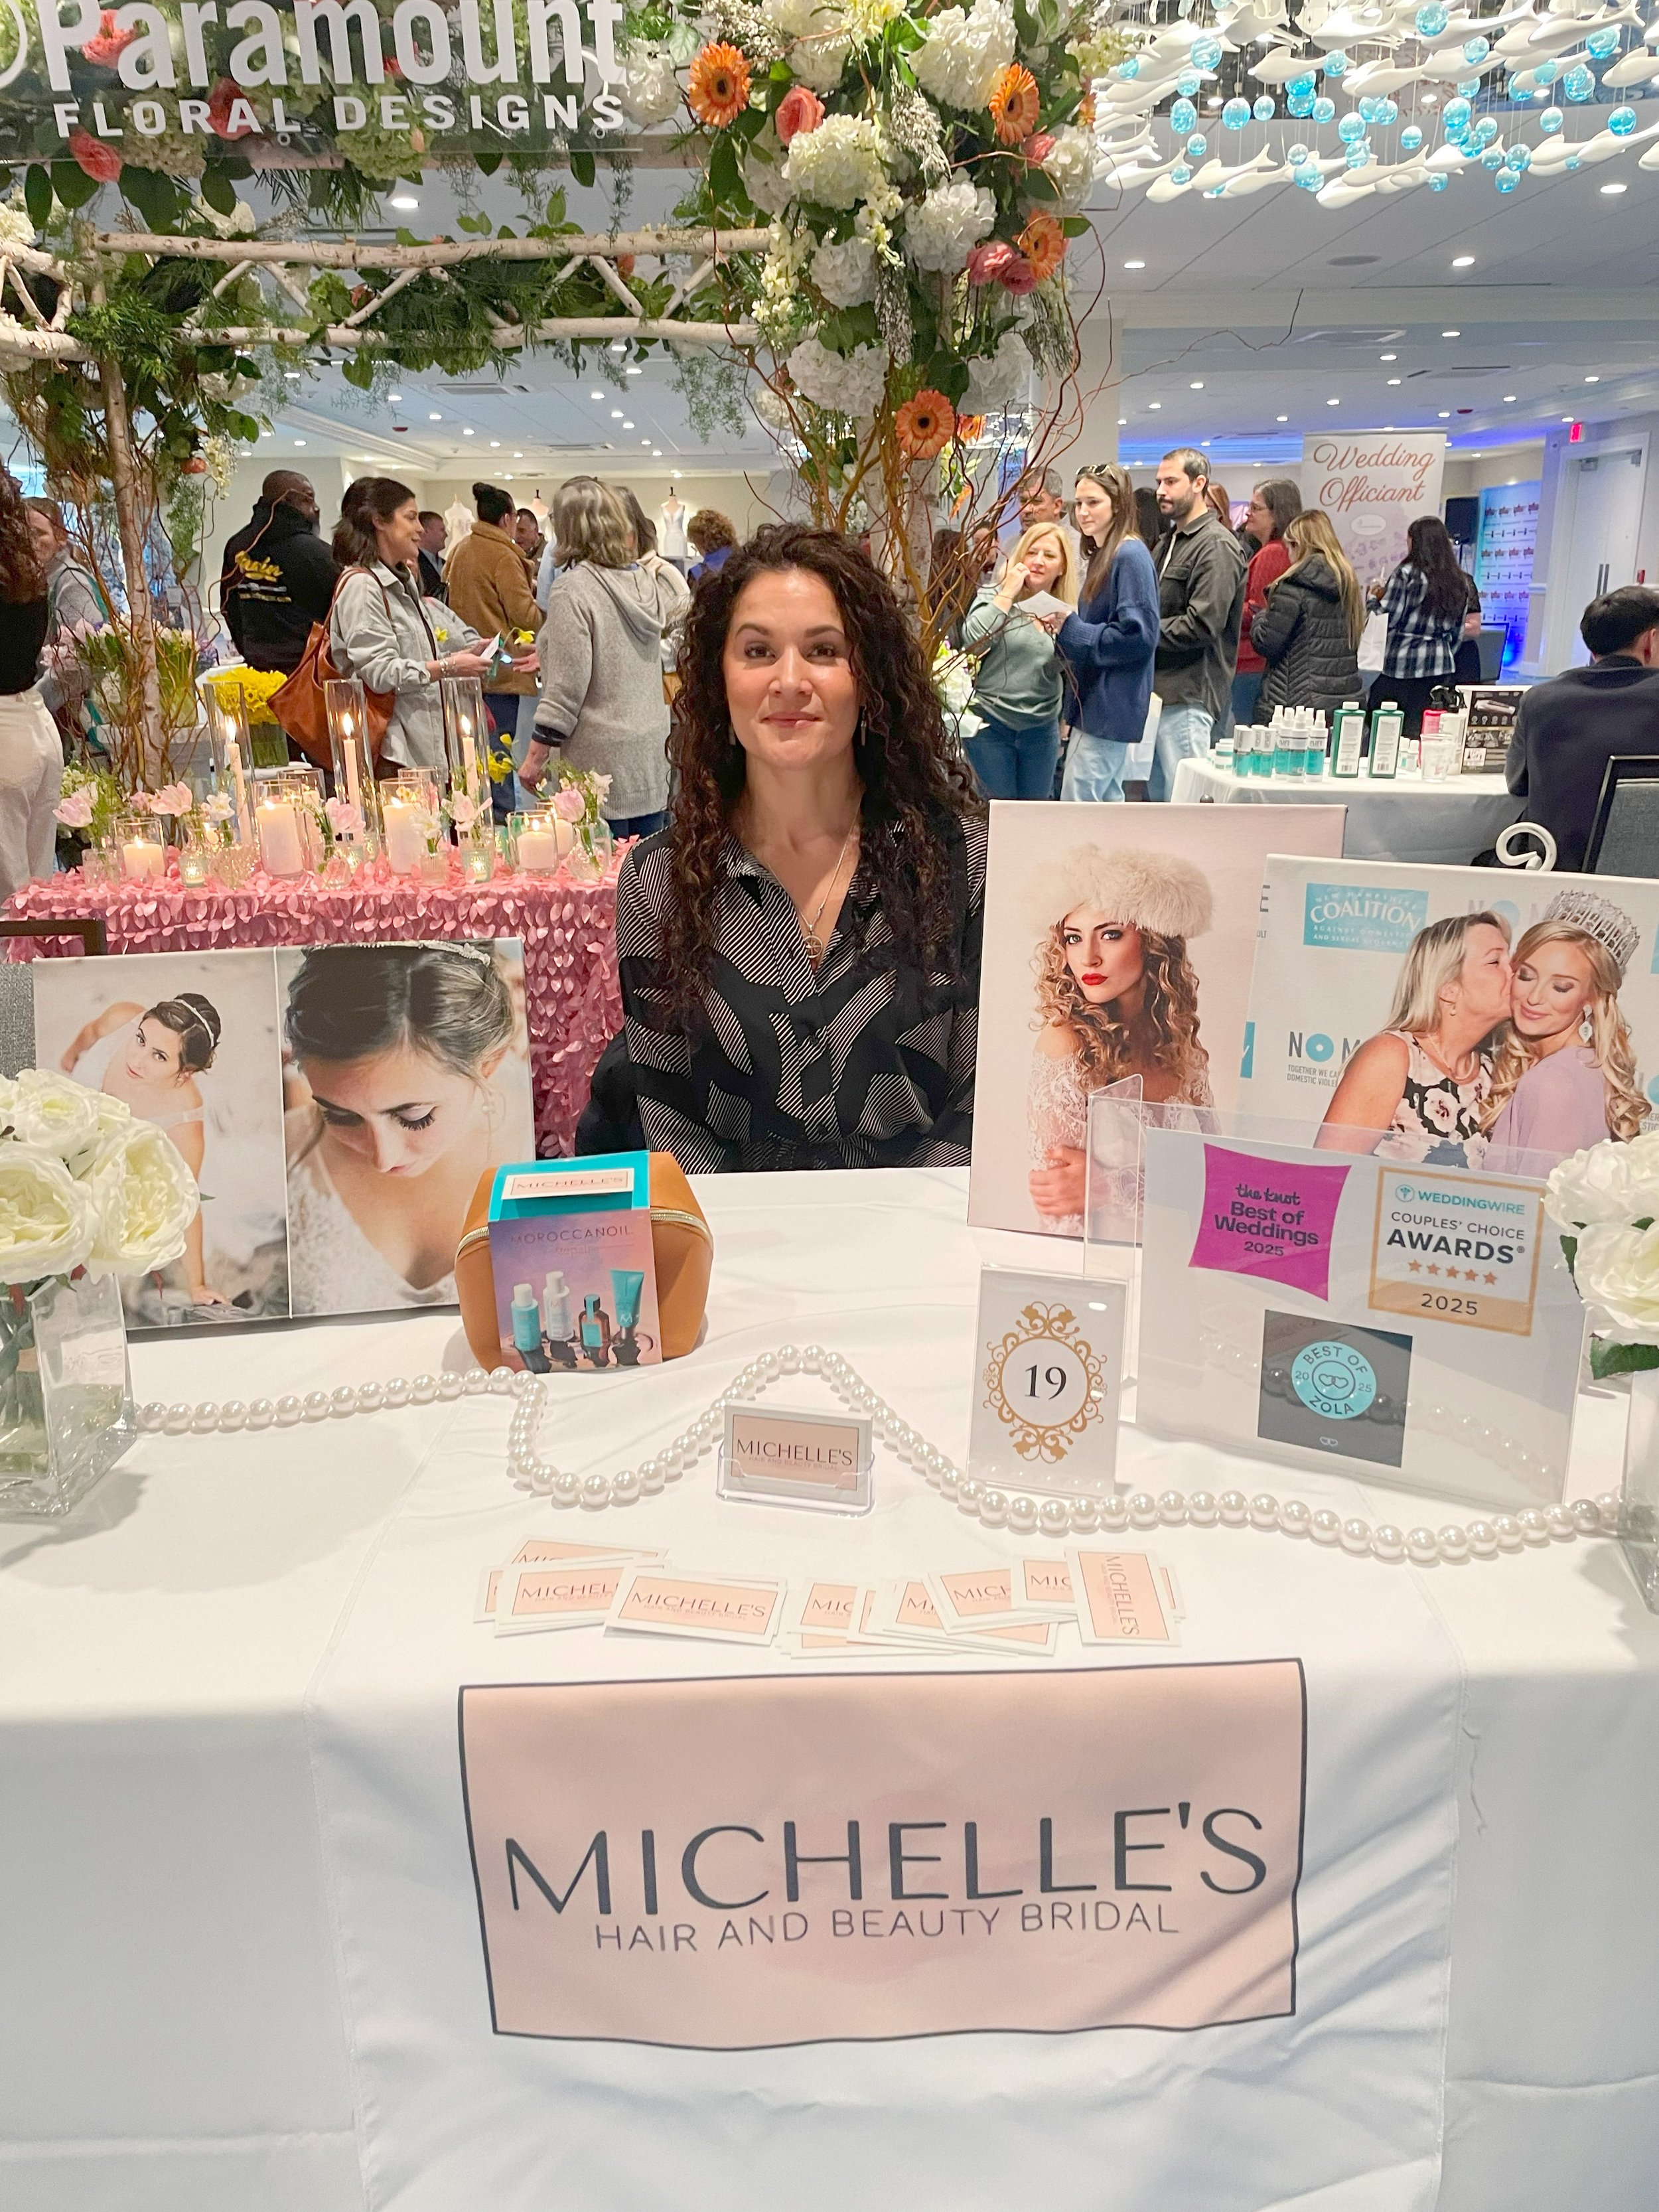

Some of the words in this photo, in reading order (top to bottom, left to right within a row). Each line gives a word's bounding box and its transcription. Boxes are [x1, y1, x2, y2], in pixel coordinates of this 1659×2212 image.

[38, 0, 625, 91] Paramount
[53, 98, 301, 138] FLORAL
[333, 94, 624, 131] DESIGNS
[1313, 443, 1436, 482] Wedding
[1319, 475, 1426, 513] Officiant
[1310, 900, 1422, 932] COALITION
[1287, 1073, 1316, 1084] DOMESTIC
[1318, 1079, 1336, 1088] VIOLE
[1288, 1065, 1317, 1076] TOGETHER
[517, 1177, 622, 1190] MICHELLE'S
[1235, 1183, 1262, 1201] the
[1263, 1187, 1301, 1206] knot
[1230, 1201, 1277, 1221] Best
[1281, 1210, 1305, 1226] of
[1418, 1190, 1526, 1216] WEDDINGWIRE
[510, 1225, 632, 1245] MOROCCANOIL
[1214, 1214, 1320, 1247] Weddings
[1391, 1211, 1463, 1230] COUPLES'
[1467, 1222, 1525, 1240] CHOICE
[1244, 1241, 1285, 1257] 2025
[1421, 1293, 1478, 1316] 2025
[1303, 1345, 1343, 1365] BEST
[1347, 1355, 1368, 1374] OF
[1025, 1364, 1067, 1400] 19
[1309, 1395, 1355, 1415] ZOLA
[737, 1439, 853, 1467] MICHELLE'S
[632, 1592, 766, 1618] MICHELLE'S
[506, 1801, 1267, 1915] MICHELLE'S
[596, 1923, 697, 1952] HAIR
[718, 1911, 808, 1950] AND
[832, 1907, 1000, 1937] BEAUTY
[1021, 1901, 1179, 1934] BRIDAL
